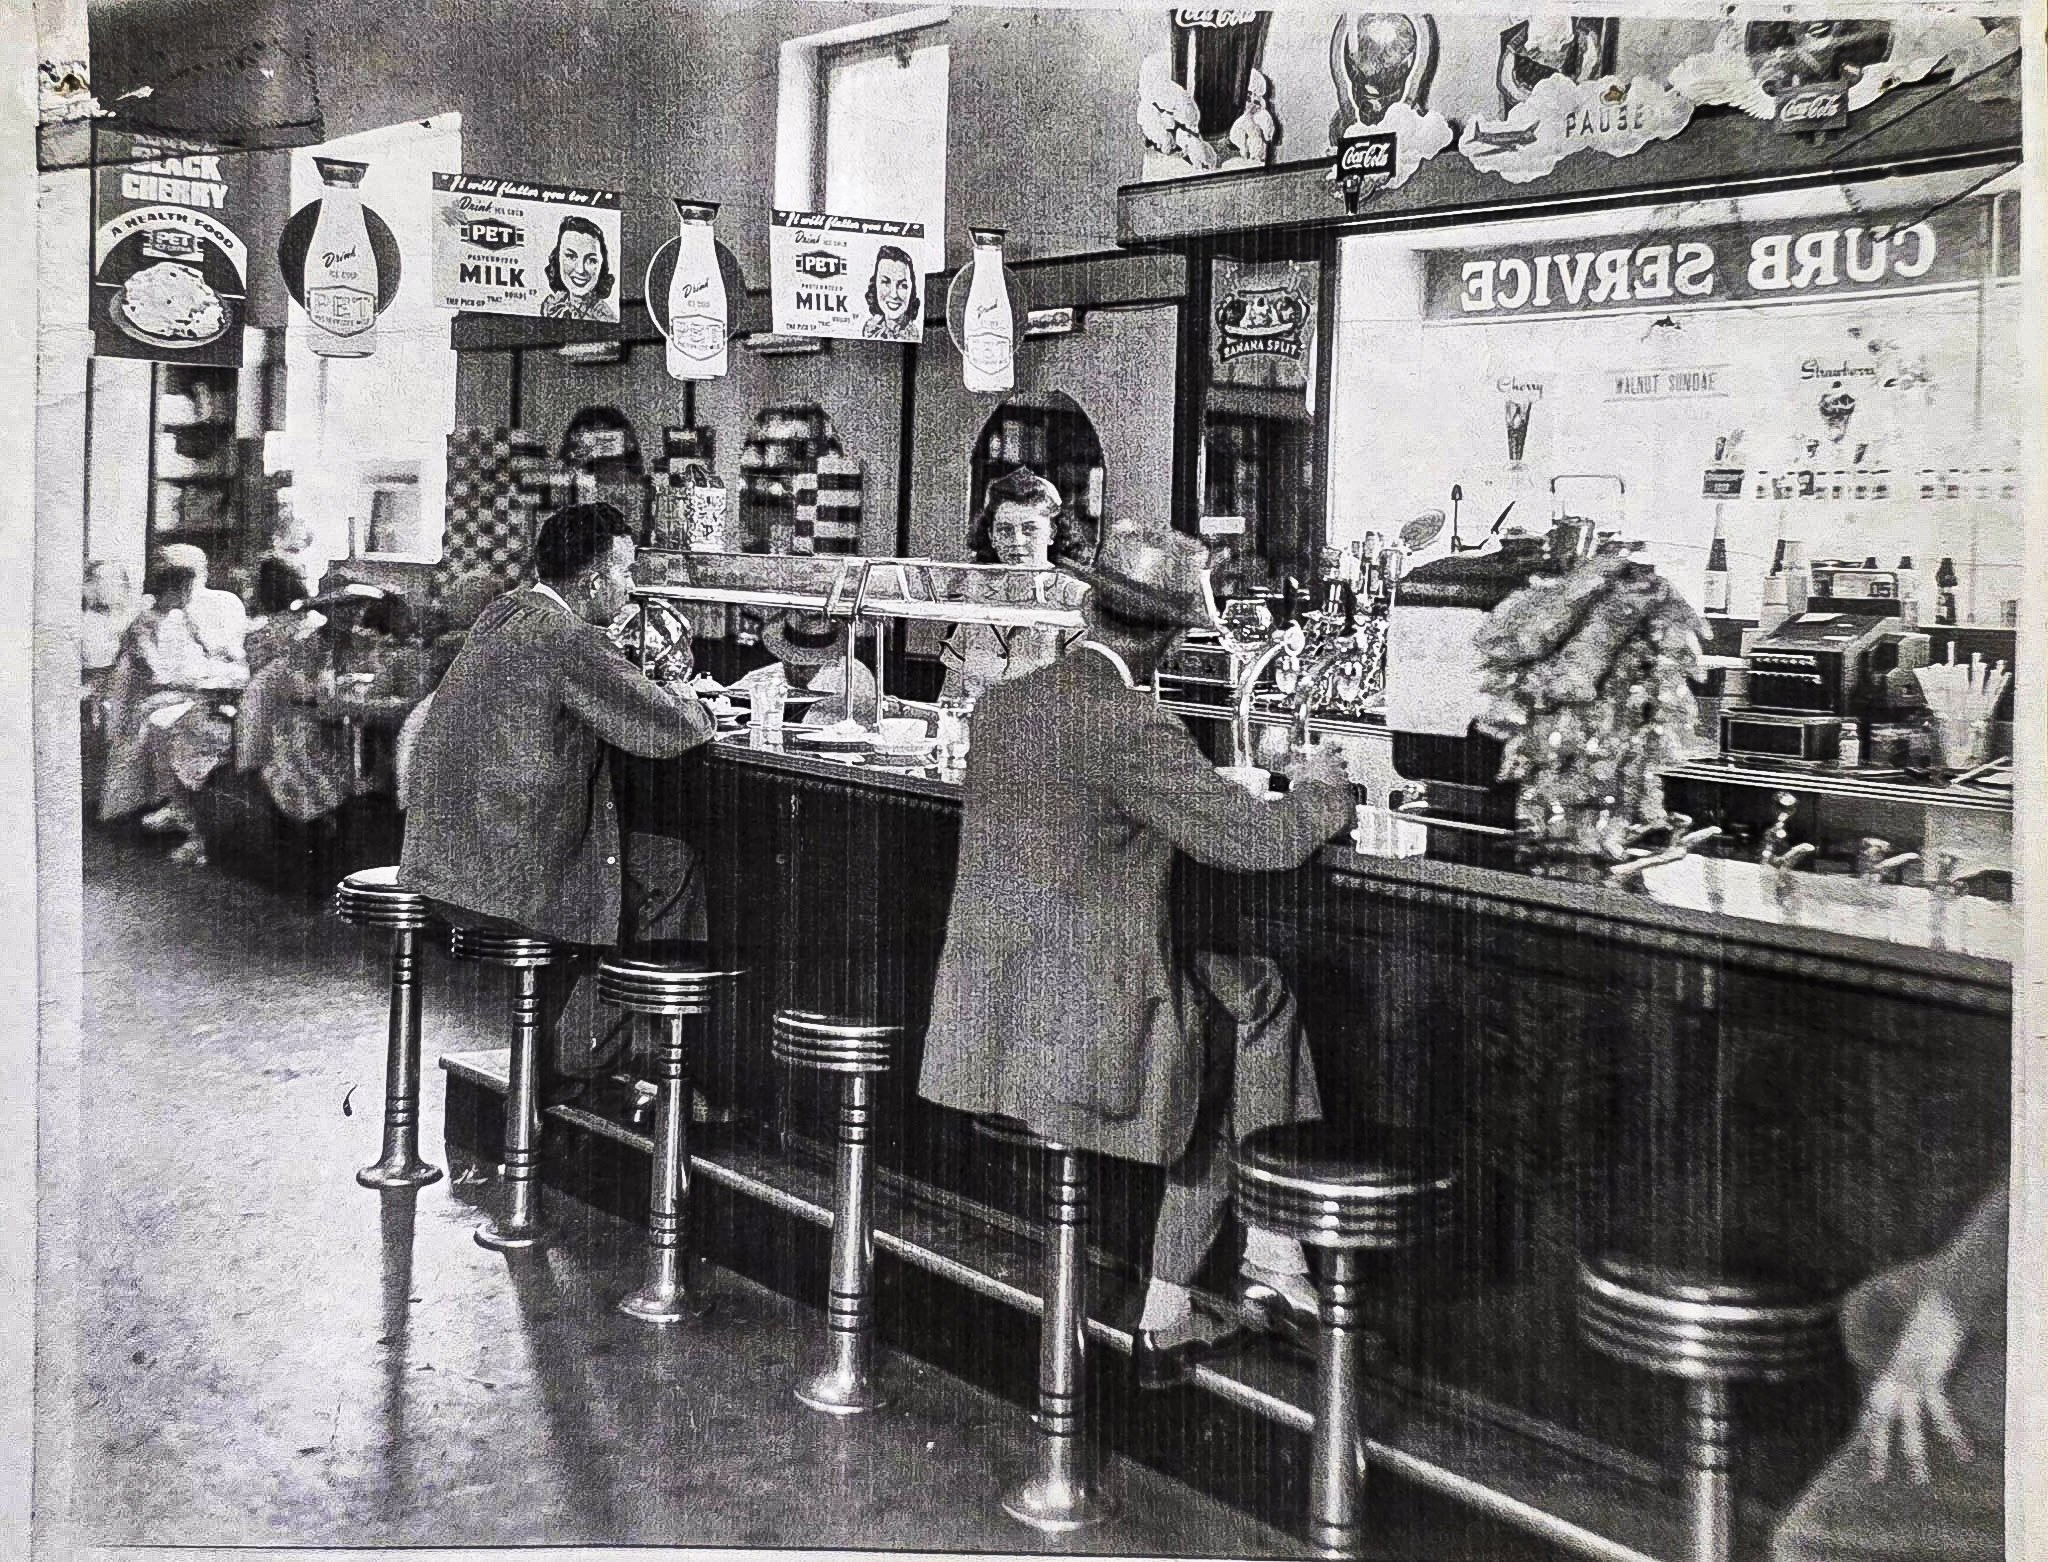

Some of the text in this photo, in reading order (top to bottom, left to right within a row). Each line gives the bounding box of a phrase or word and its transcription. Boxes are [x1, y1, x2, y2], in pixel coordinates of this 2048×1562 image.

[1565, 104, 1643, 138] PAUSE
[121, 173, 228, 209] CHERRY
[459, 196, 492, 213] Drink
[112, 227, 122, 237] A
[125, 212, 188, 228] HEALTH
[195, 219, 233, 249] FOOD
[156, 232, 193, 247] PET
[472, 225, 513, 243] PET
[795, 230, 821, 244] Drink
[322, 245, 356, 268] Drink
[805, 257, 839, 273] PET
[459, 263, 525, 288] MILK
[796, 292, 848, 312] MILK
[1224, 340, 1297, 357] BANANA SPLIT
[1496, 376, 1544, 399] Cherry
[1615, 371, 1718, 394] WALNUT SUNDAE
